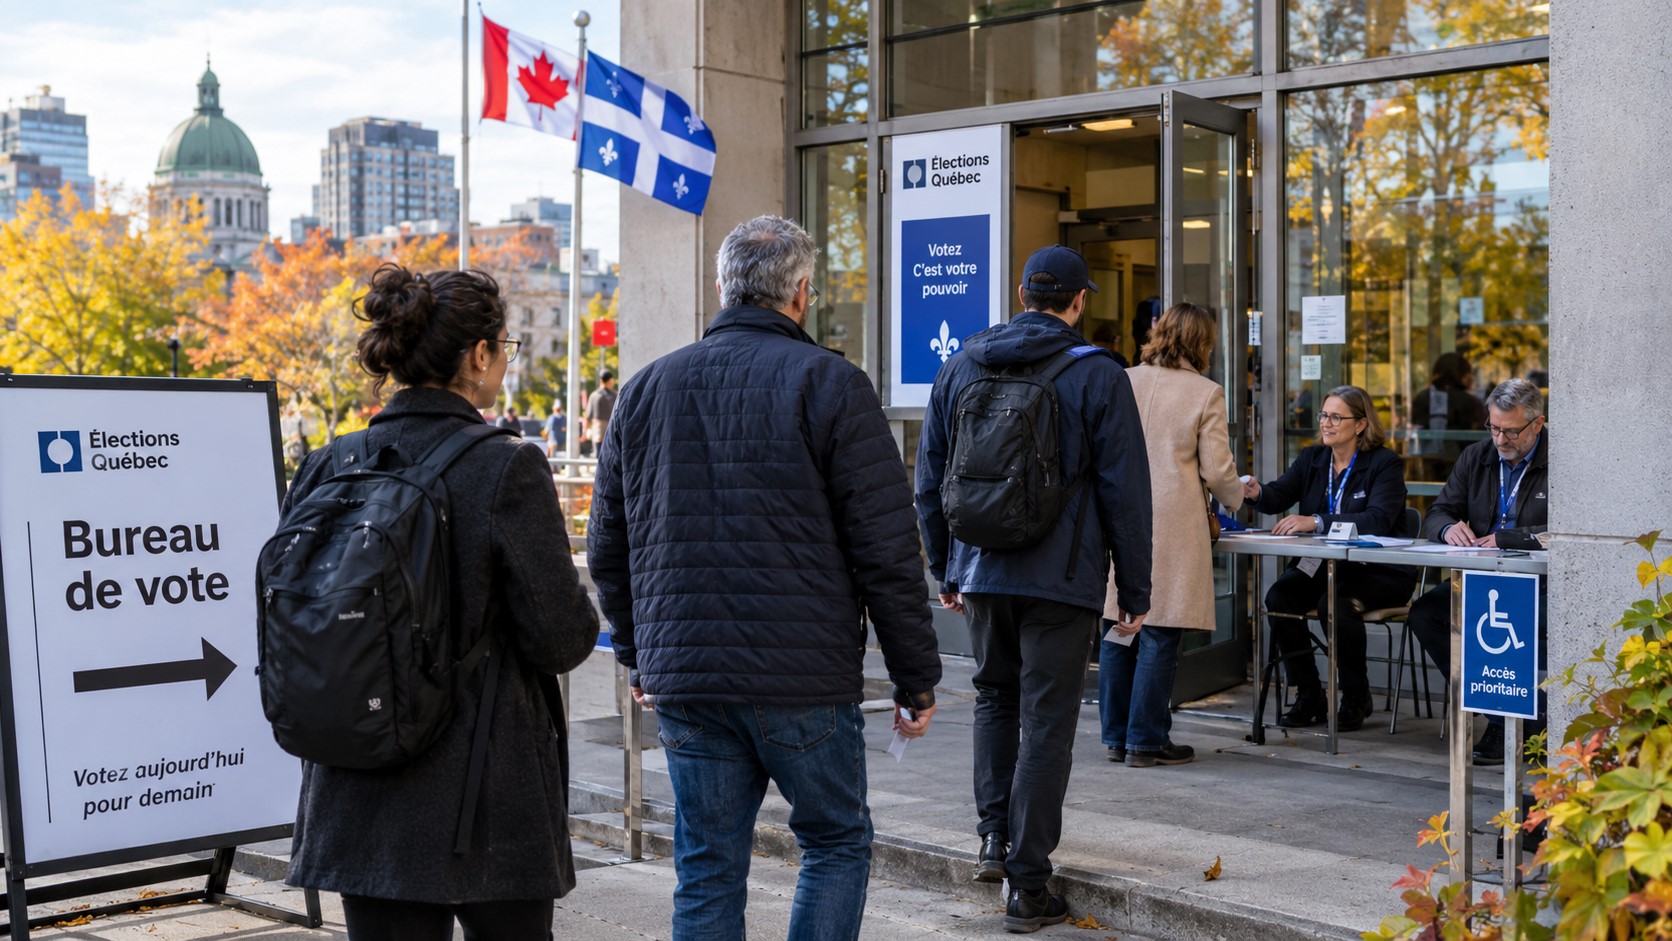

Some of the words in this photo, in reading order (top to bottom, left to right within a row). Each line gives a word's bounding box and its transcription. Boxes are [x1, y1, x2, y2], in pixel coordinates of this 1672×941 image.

[931, 153, 990, 171] Élections
[931, 171, 981, 188] Québec
[928, 243, 962, 257] Votez
[913, 263, 943, 277] C'est
[945, 262, 978, 276] votre
[922, 280, 969, 299] pouvoir
[89, 428, 180, 449] Élections
[91, 451, 169, 472] Québec
[63, 519, 220, 559] Bureau
[65, 570, 123, 612] de
[135, 566, 230, 606] vote
[1470, 680, 1528, 698] prioritaire
[73, 767, 129, 788] Votez
[135, 747, 245, 781] aujourd’hui
[83, 794, 133, 821] pour
[139, 781, 213, 807] demain
